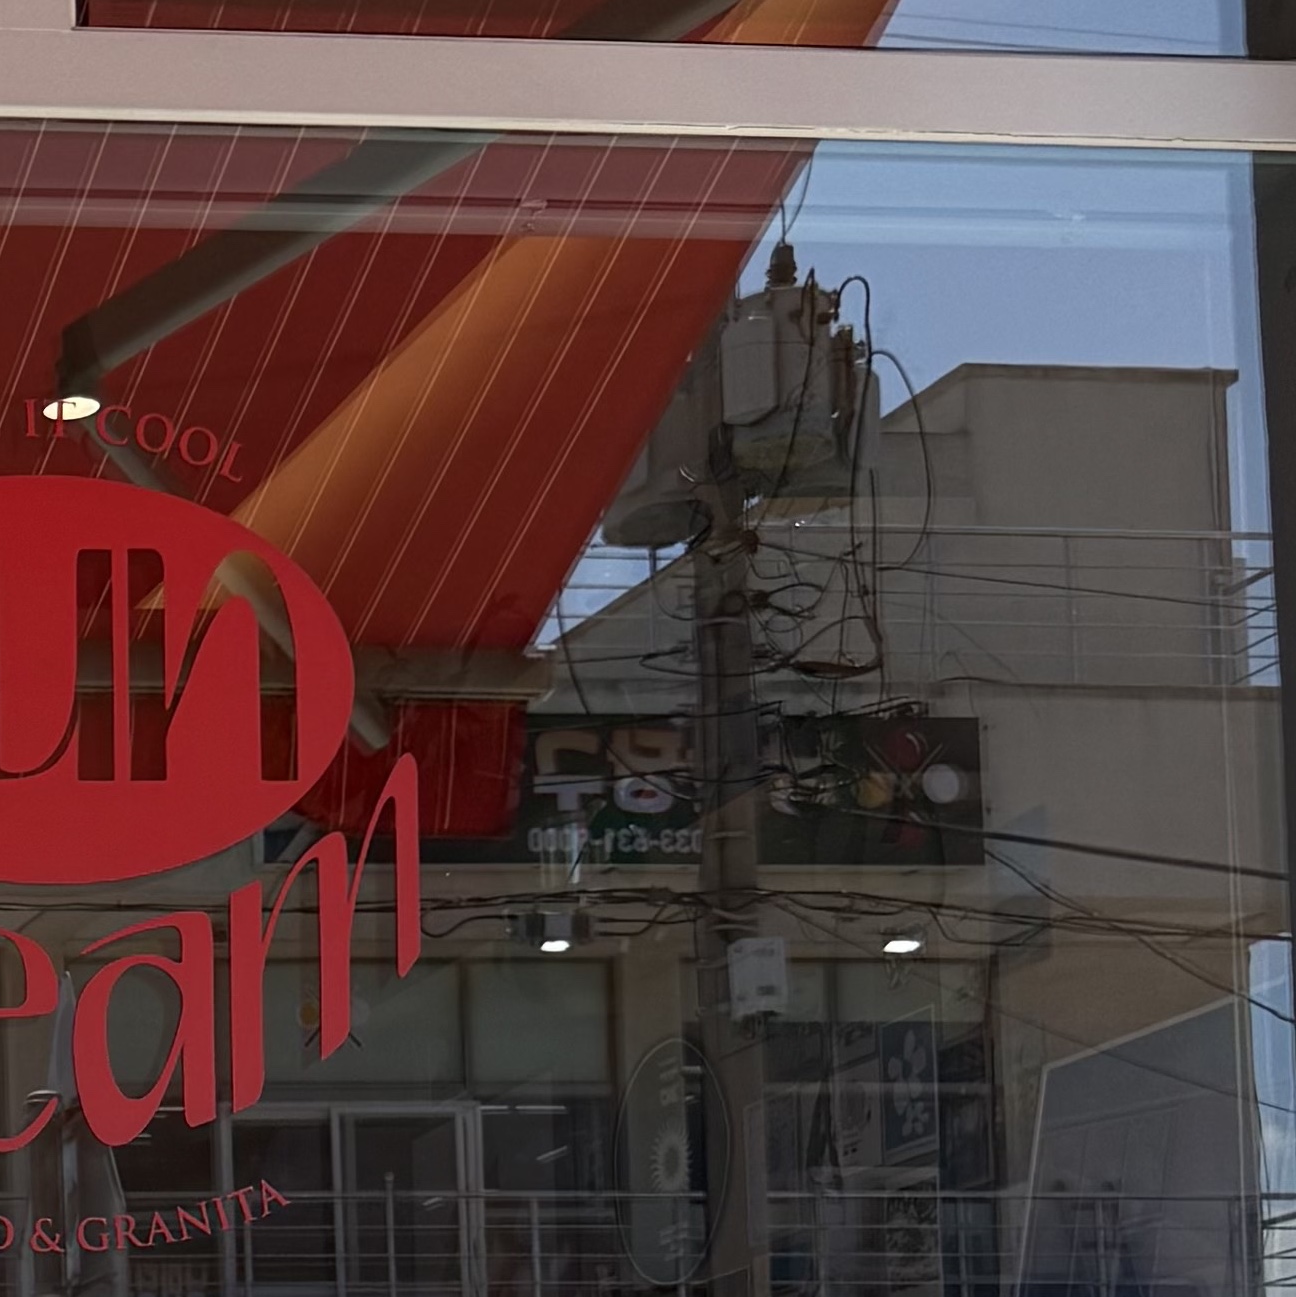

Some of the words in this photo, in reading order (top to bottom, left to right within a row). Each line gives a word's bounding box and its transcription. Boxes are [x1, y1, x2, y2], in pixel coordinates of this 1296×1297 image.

[24, 398, 77, 439] IT
[96, 405, 247, 485] COOL
[28, 1217, 66, 1254] &
[75, 1178, 292, 1253] GRANITA
